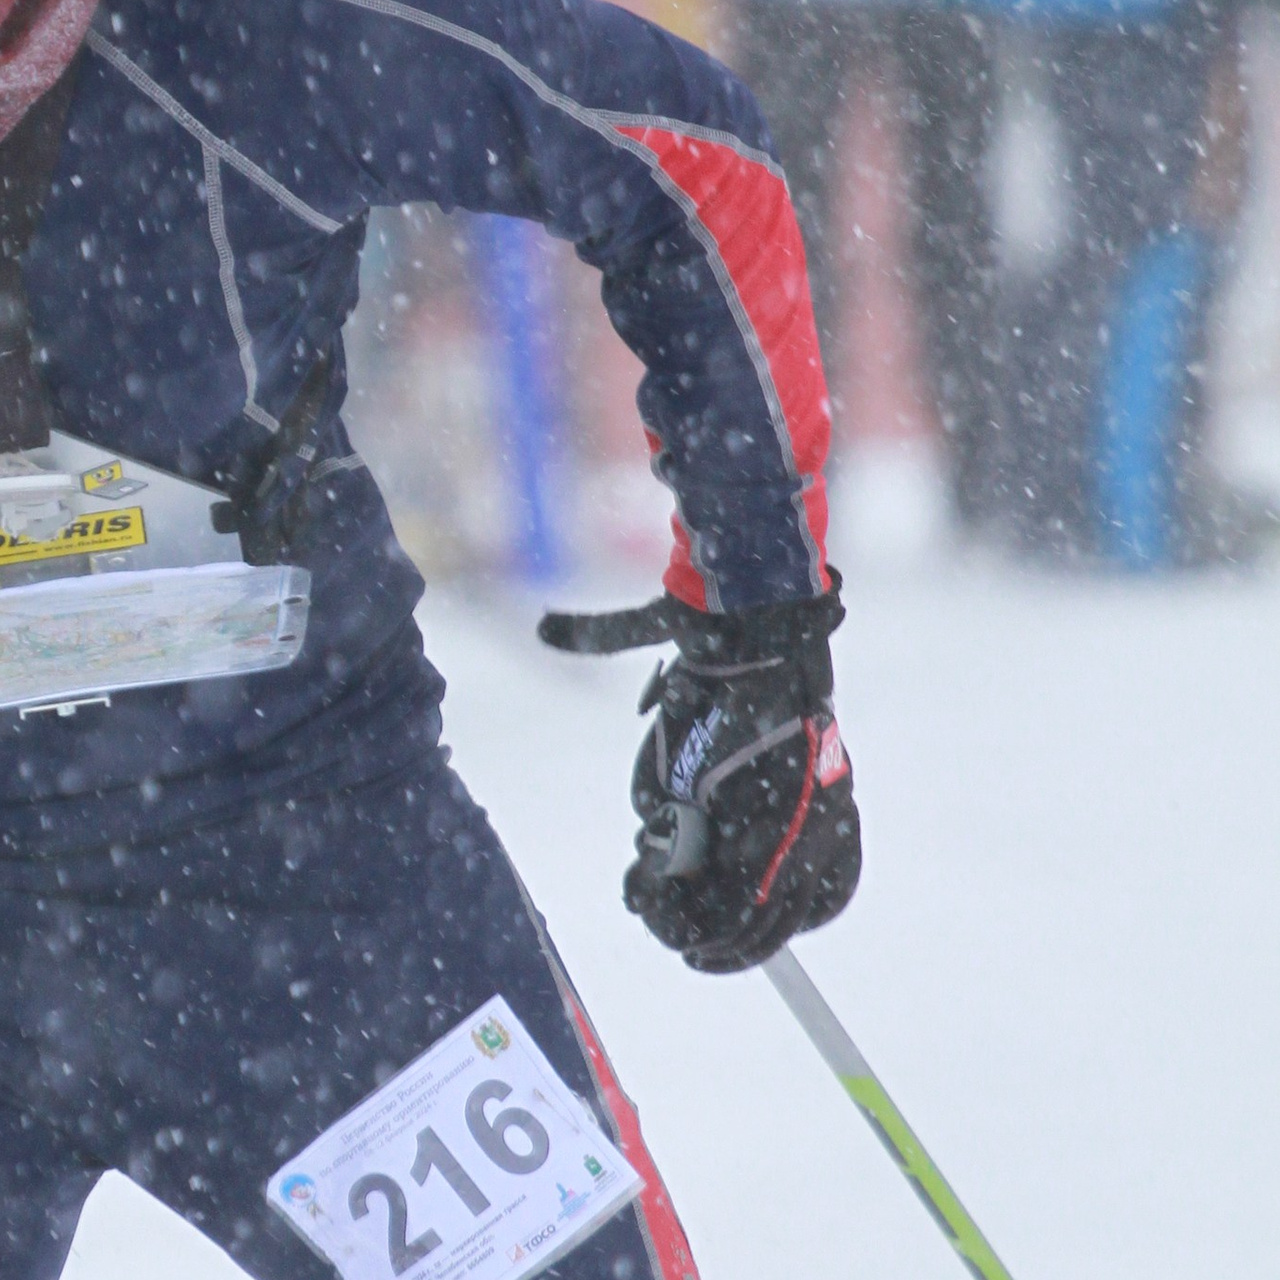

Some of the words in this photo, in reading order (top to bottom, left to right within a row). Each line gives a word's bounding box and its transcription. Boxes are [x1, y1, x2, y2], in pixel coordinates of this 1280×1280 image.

[391, 1054, 475, 1124] ориентированию
[396, 1070, 434, 1101] России
[348, 1079, 550, 1277] 216
[522, 1222, 557, 1253] ТФСО
